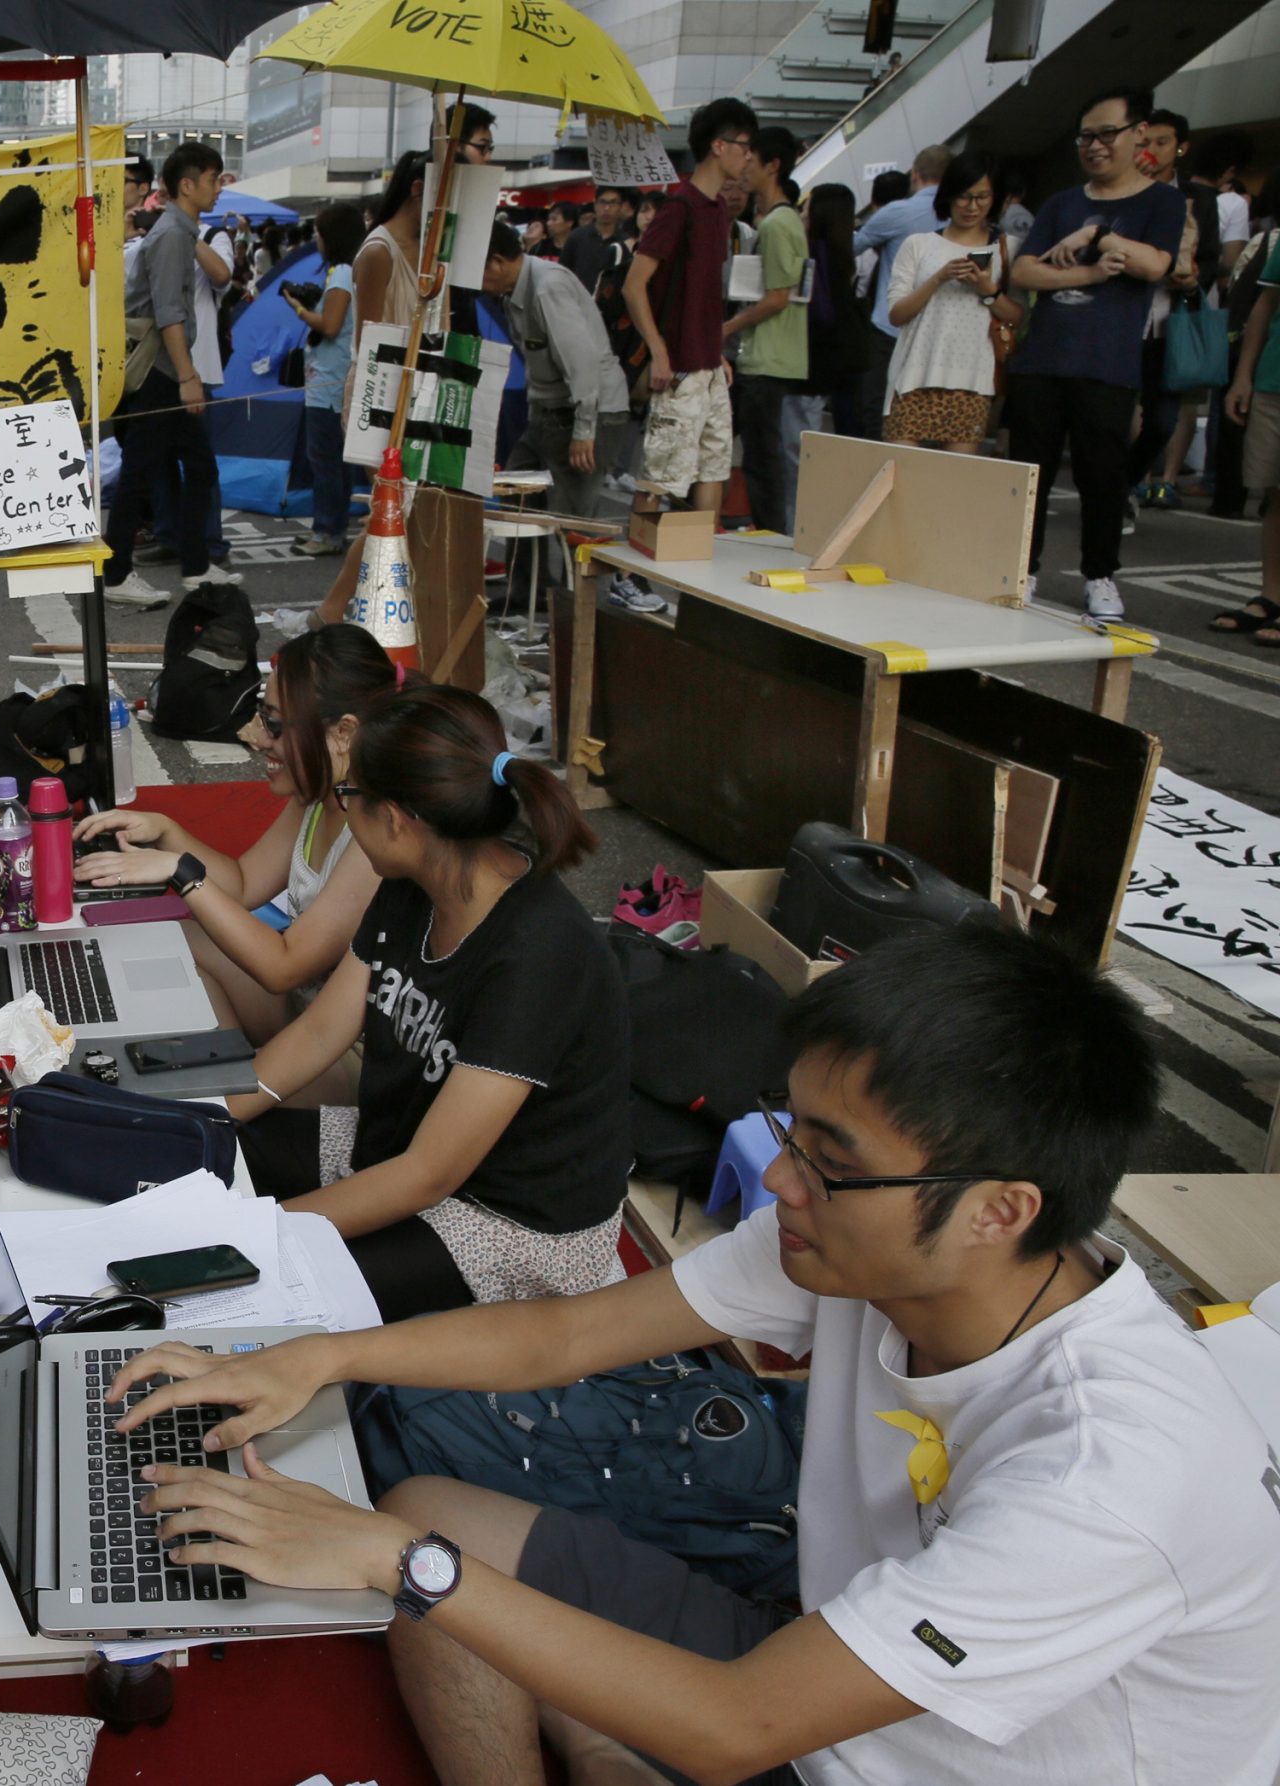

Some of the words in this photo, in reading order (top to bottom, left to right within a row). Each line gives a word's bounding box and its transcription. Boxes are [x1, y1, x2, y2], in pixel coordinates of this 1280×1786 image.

[390, 0, 483, 46] VOTE
[496, 191, 520, 206] FC
[3, 492, 73, 519] Center
[932, 1637, 960, 1661] AIGLE
